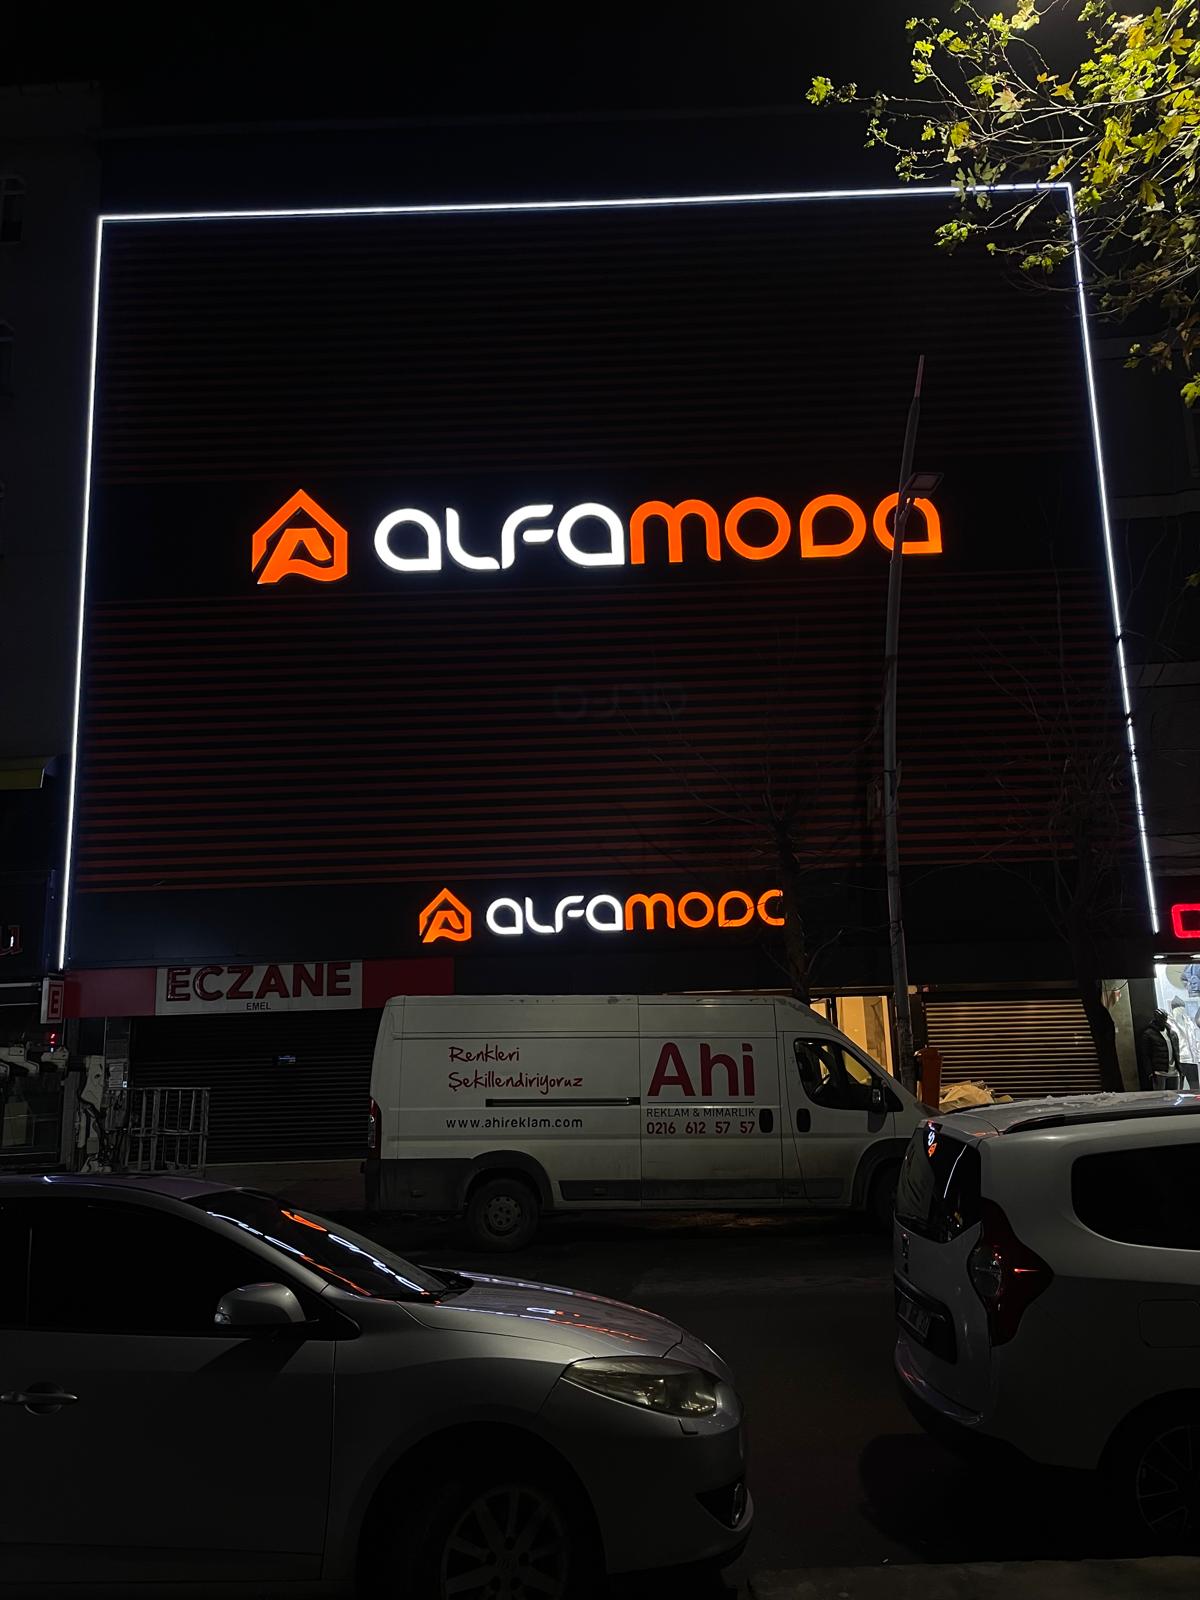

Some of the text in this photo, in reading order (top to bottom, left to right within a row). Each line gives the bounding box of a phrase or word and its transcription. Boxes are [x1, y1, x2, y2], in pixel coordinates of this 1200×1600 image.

[166, 962, 351, 1001] ECZANE
[246, 1001, 271, 1010] EMEL
[449, 1044, 520, 1062] Renkleri
[647, 1042, 756, 1097] Ahi
[448, 1072, 584, 1095] Şekillendiriyoruz
[646, 1108, 689, 1117] REKLAM
[693, 1108, 700, 1117] &
[446, 1117, 583, 1129] www.ahireklam.com
[646, 1122, 755, 1134] 0216 612 57 57
